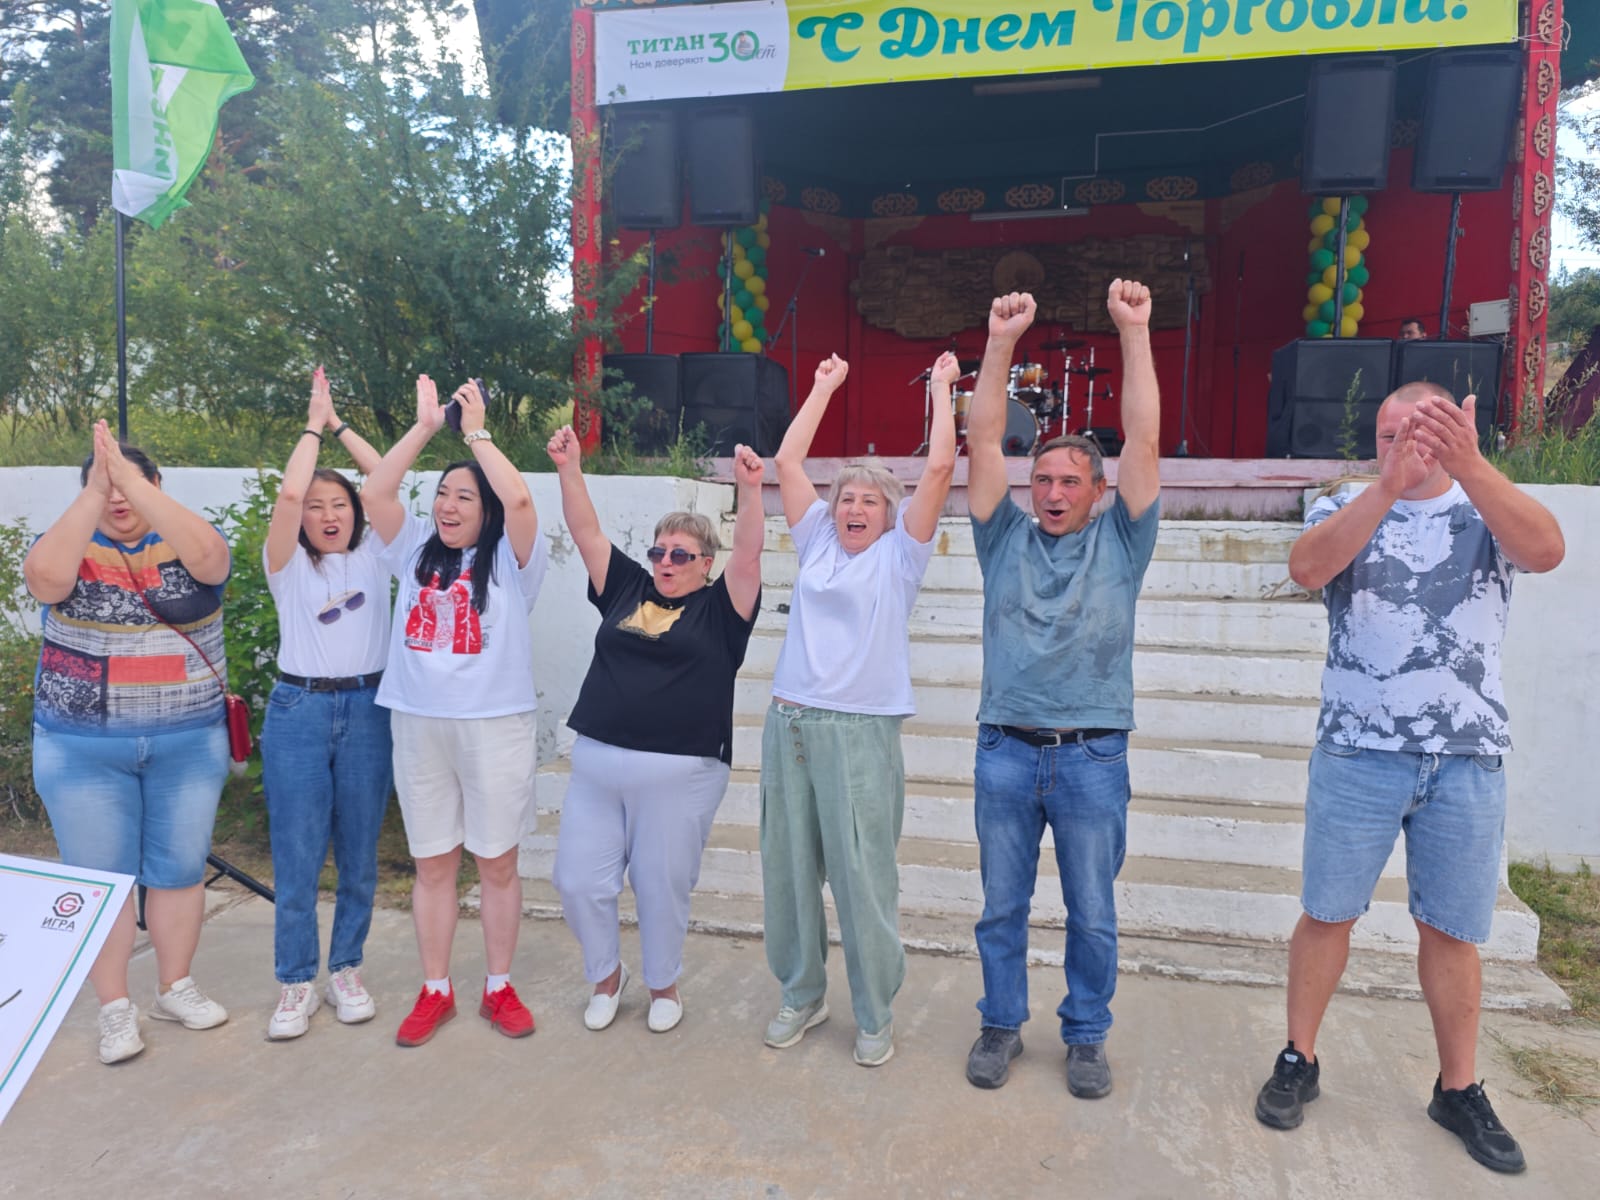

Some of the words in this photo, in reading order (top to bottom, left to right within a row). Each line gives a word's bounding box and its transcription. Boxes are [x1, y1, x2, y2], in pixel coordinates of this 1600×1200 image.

[627, 34, 705, 55] ТИТАН
[708, 30, 760, 63] 30
[797, 12, 864, 63] С
[878, 7, 1077, 60] Днем
[630, 59, 652, 70] Нам
[654, 56, 704, 69] доверяют
[42, 916, 75, 931] ИГРА
